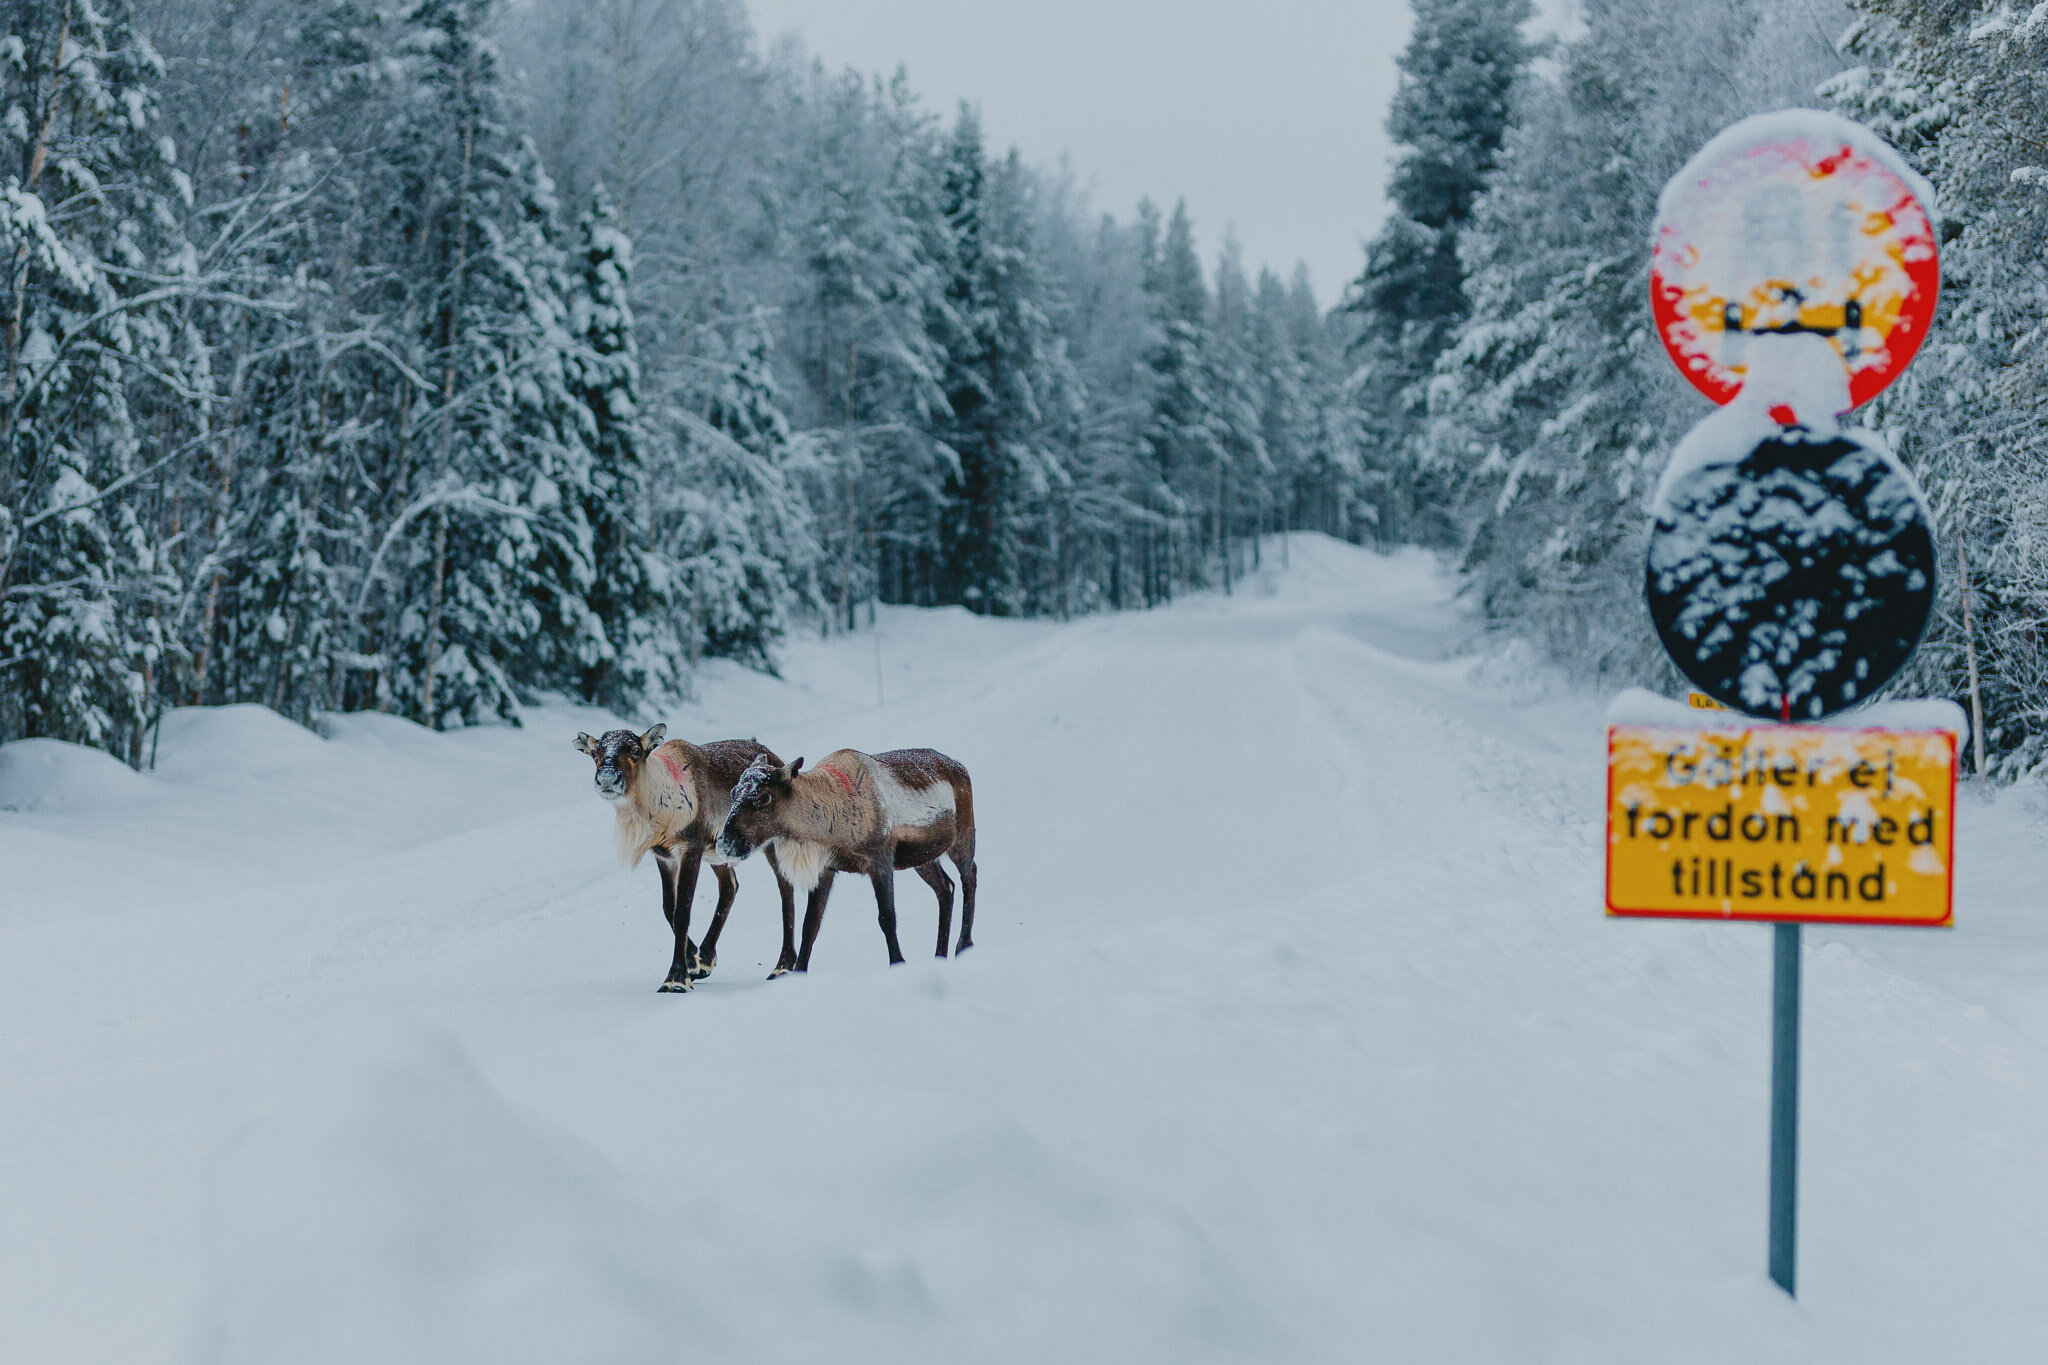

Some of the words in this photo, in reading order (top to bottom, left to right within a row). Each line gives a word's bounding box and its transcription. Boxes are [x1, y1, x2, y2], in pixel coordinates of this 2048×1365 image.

[1849, 748, 1894, 799] ej
[1625, 802, 1801, 844] fordon
[1671, 856, 1887, 902] tillstånd
